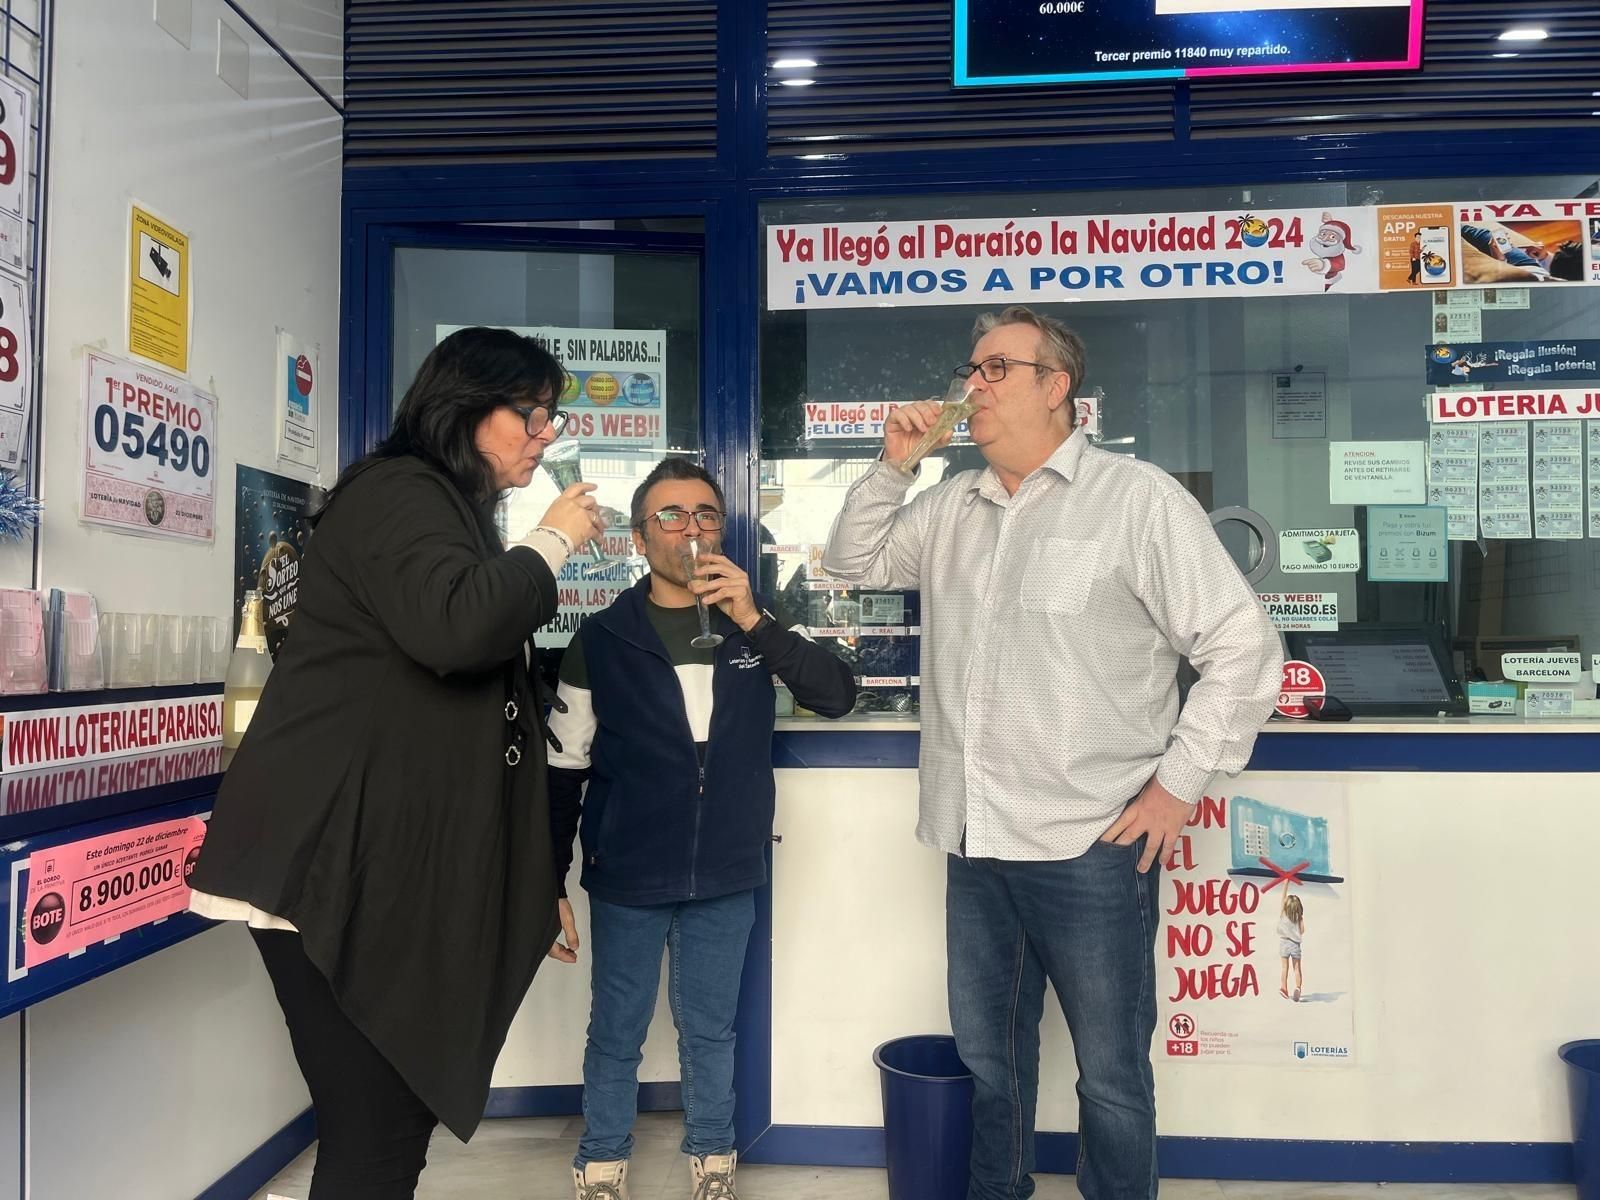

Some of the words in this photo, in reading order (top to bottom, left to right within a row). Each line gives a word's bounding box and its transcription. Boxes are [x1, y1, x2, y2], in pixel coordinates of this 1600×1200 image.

[1039, 1, 1085, 15] 60.000€
[1095, 51, 1130, 62] Tercer
[1132, 50, 1171, 63] premio
[1174, 47, 1207, 58] 11840
[1209, 47, 1233, 60] muy
[1236, 44, 1291, 59] repartido.
[1384, 222, 1416, 233] APP
[776, 229, 814, 263] Ya
[823, 225, 890, 267] llegó
[898, 225, 925, 259] al
[934, 221, 1043, 258] Paraíso
[1051, 221, 1078, 255] la
[1087, 215, 1216, 254] Navidad
[795, 269, 968, 303] ¡VAMOS
[983, 268, 1014, 291] A
[1030, 265, 1125, 290] POR
[1140, 260, 1284, 288] OTRO!
[567, 339, 586, 360] SIN
[136, 372, 163, 389] VENDIDO
[123, 382, 201, 432] PREMIO
[806, 404, 827, 421] Ya
[831, 404, 866, 424] llegó
[870, 404, 884, 421] al
[1439, 394, 1568, 418] LOTERIA
[601, 413, 660, 438] WEB!!
[95, 404, 210, 478] 05490
[1325, 529, 1356, 537] TARJETA
[269, 597, 283, 619] NOS
[283, 587, 298, 610] UNE
[586, 589, 606, 606] LAS
[1284, 594, 1323, 602] WEB!!
[1504, 656, 1545, 664] LOTERÍA
[86, 848, 103, 861] Este
[104, 841, 136, 858] domingo
[136, 838, 147, 847] 22
[146, 835, 154, 844] de
[155, 828, 189, 842] diciembre
[43, 875, 61, 885] GORDO
[1166, 879, 1260, 916] JUEGO
[32, 908, 63, 930] BOTE
[1167, 924, 1214, 959] NO
[1225, 920, 1257, 958] SE
[1168, 963, 1260, 1003] JUEGA
[1171, 1042, 1194, 1054] +18
[1310, 1046, 1348, 1054] LOTERÍAS
